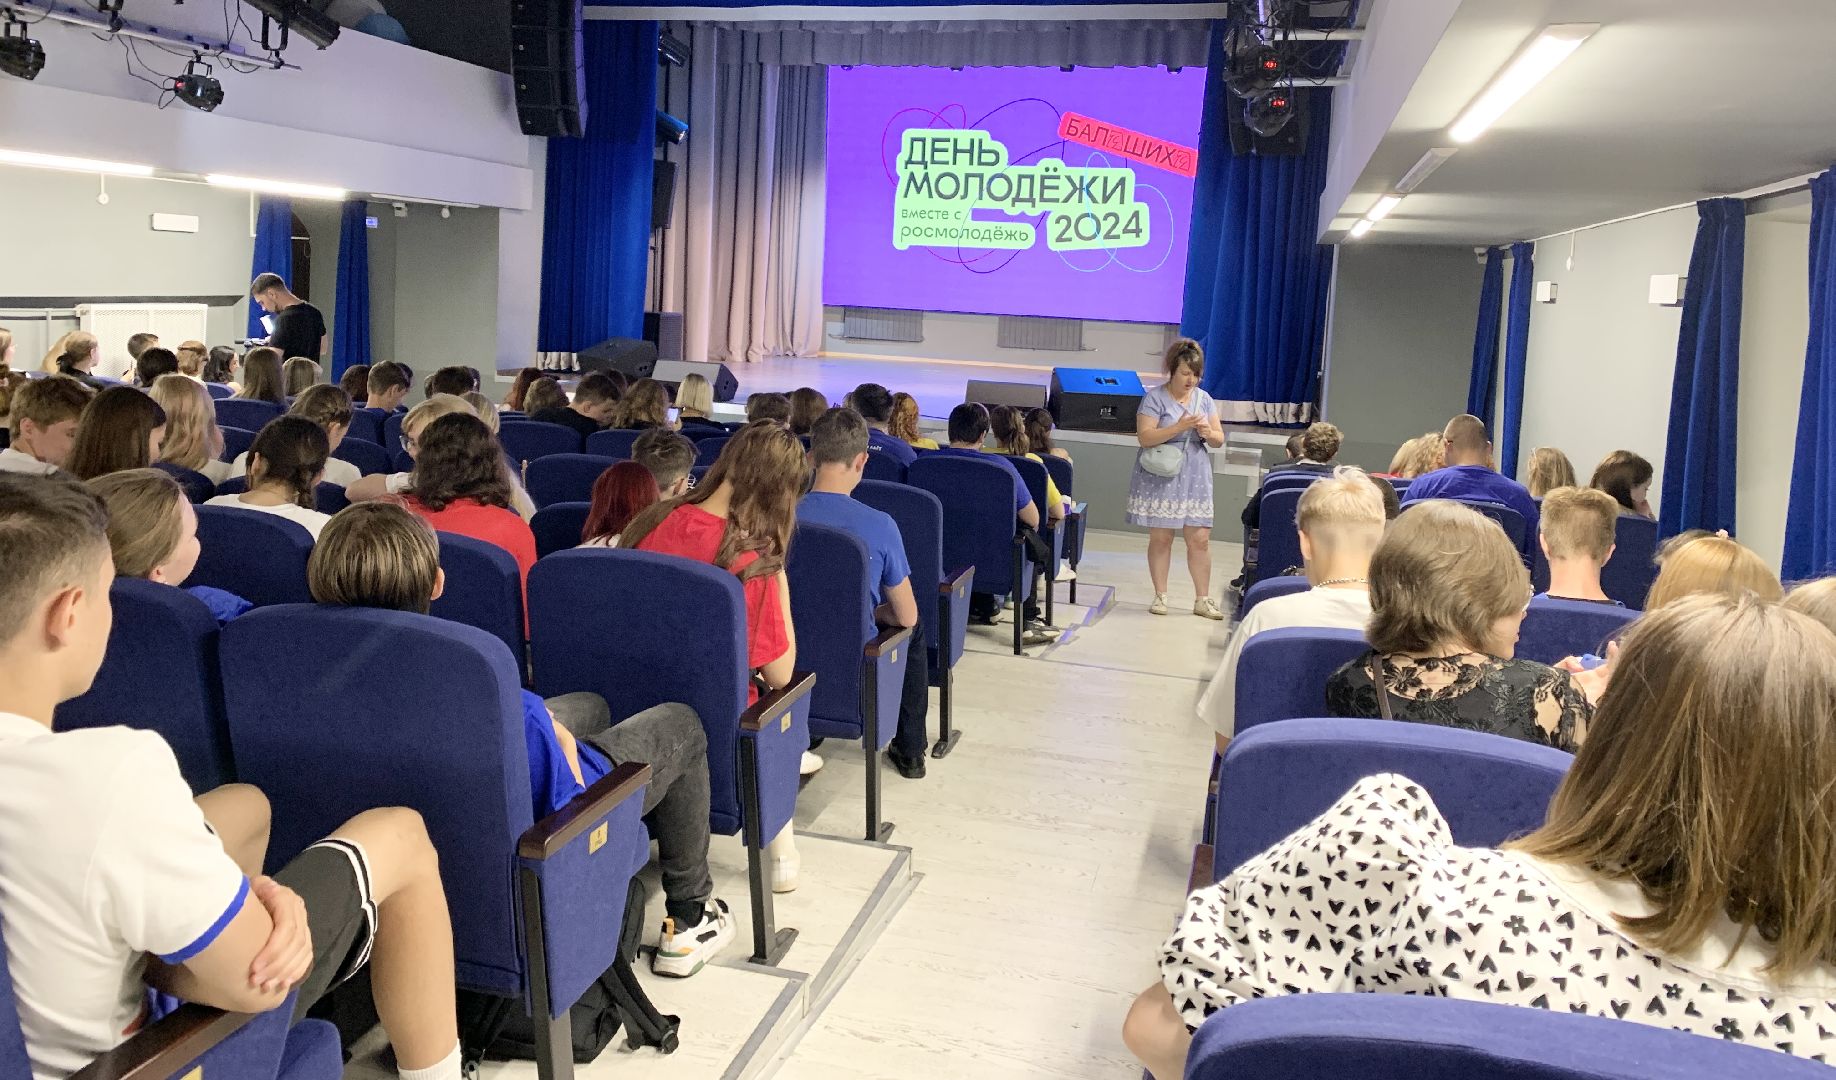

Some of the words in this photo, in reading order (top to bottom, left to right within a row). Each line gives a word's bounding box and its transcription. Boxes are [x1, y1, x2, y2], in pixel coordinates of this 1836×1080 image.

[904, 137, 1000, 170] ДЕНЬ
[903, 167, 1127, 208] МОЛОДЁЖИ
[901, 209, 949, 220] вместе
[954, 211, 962, 220] с
[1055, 210, 1142, 243] 2024
[901, 226, 1029, 243] росмолодёжь
